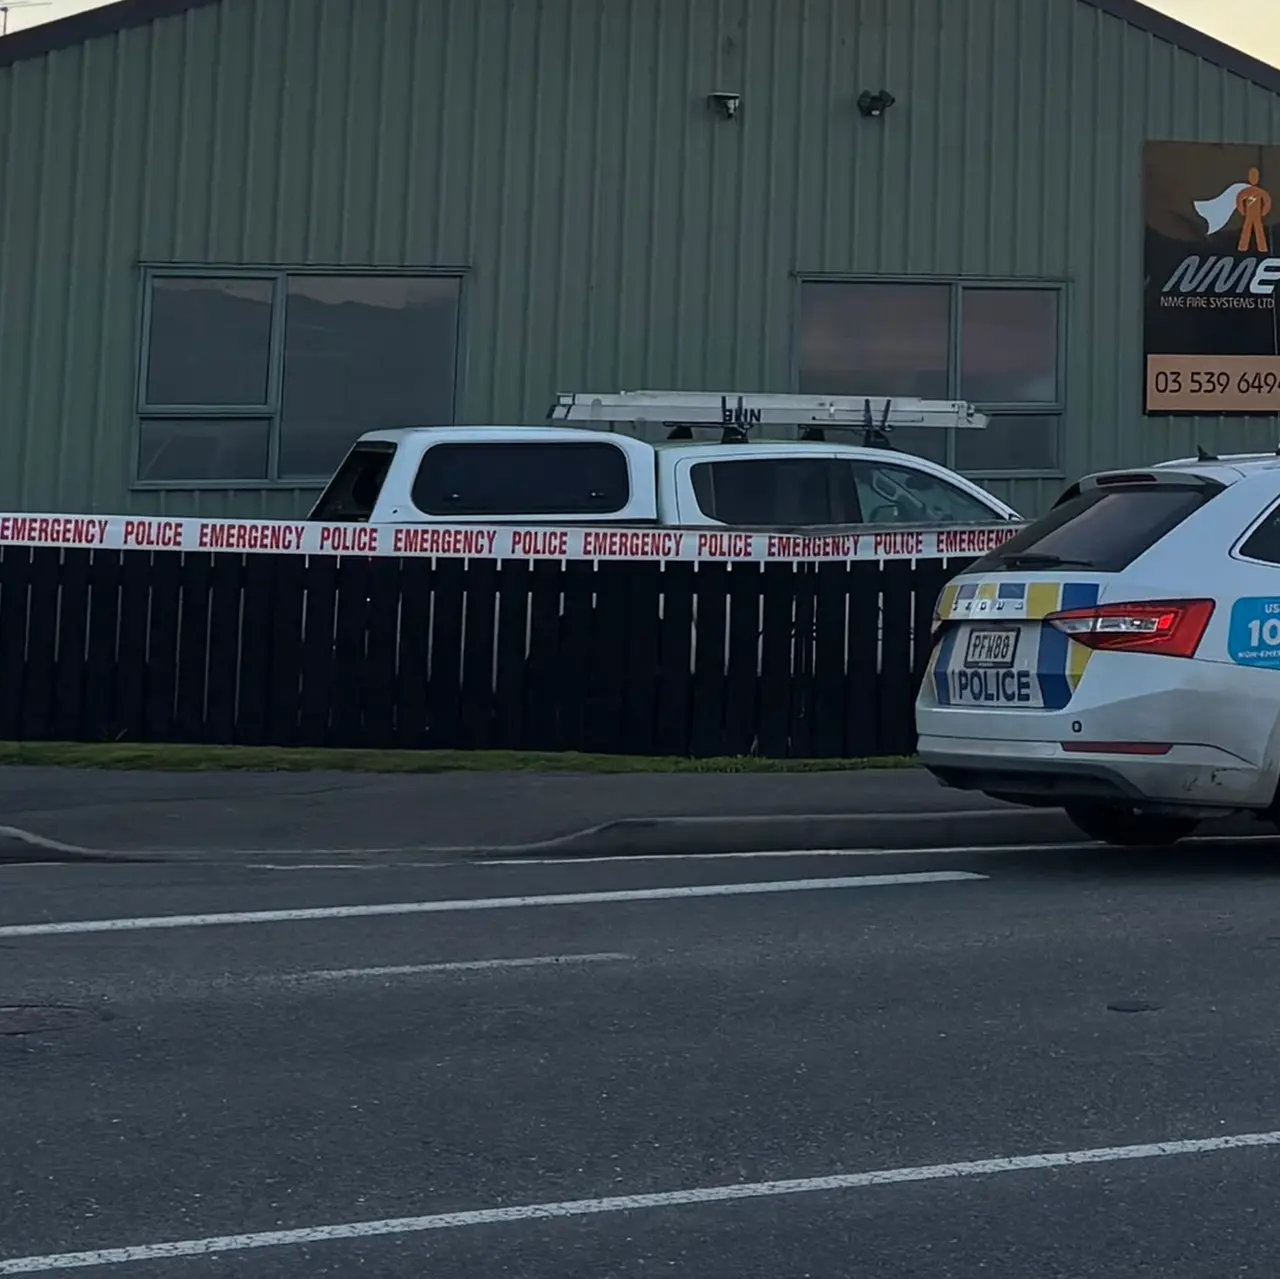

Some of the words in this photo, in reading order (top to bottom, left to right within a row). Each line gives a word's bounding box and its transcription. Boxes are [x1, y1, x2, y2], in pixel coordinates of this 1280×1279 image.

[1160, 296, 1184, 308] NME
[1186, 296, 1208, 309] FIRE
[1209, 296, 1255, 310] SYSTEMS
[1257, 297, 1275, 309] LTD
[1154, 371, 1183, 394] 03
[1189, 371, 1231, 394] 539
[0, 517, 108, 545] EMERGENCY
[123, 521, 183, 546] POLICE
[199, 524, 305, 550] EMERGENCY
[320, 527, 378, 552] POLICE
[393, 528, 497, 554] EMERGENCY
[511, 531, 568, 555] POLICE
[583, 532, 683, 557] EMERGENCY
[698, 533, 753, 558] POLICE
[767, 533, 861, 557] EMERGENCY
[874, 531, 924, 555] POLICE
[959, 670, 1031, 701] POLICE
